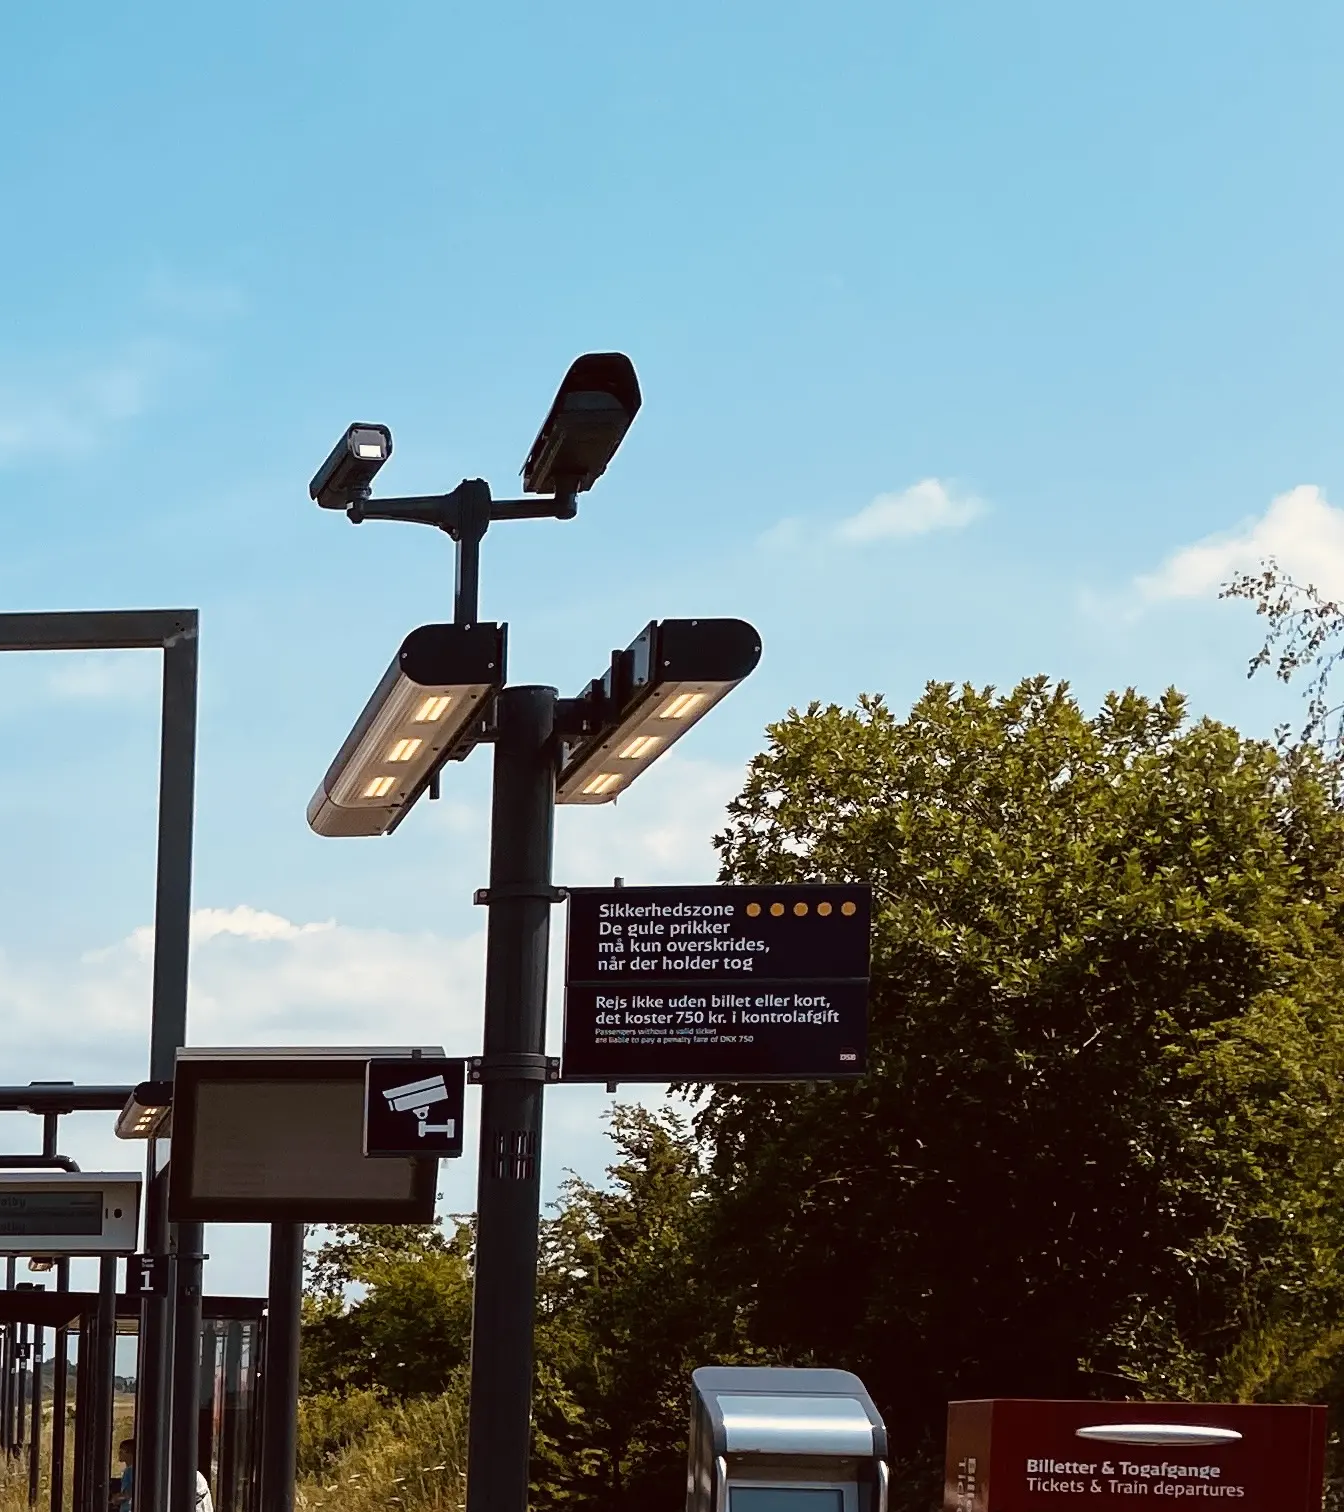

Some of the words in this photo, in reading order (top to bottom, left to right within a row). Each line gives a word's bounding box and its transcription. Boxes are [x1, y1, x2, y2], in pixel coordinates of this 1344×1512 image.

[599, 902, 735, 918] Sikkerhedszone
[599, 921, 623, 936] De
[627, 920, 665, 938] gule
[670, 919, 731, 938] prikker
[598, 938, 624, 953] må
[630, 938, 662, 953] kun
[666, 936, 770, 954] overskrides,
[597, 955, 627, 971] når
[630, 956, 659, 971] der
[662, 955, 720, 970] holder
[723, 956, 754, 972] tog
[595, 995, 628, 1011] Rejs
[632, 995, 664, 1008] ikke
[668, 994, 707, 1008] uden
[711, 994, 752, 1008] billet
[755, 993, 791, 1007] eller
[794, 993, 831, 1009] kort,
[595, 1011, 622, 1025] det
[625, 1011, 674, 1025] koster
[675, 1010, 705, 1024] 750
[708, 1010, 728, 1024] kr.
[732, 1010, 737, 1024] i
[741, 1009, 840, 1025] kontrolafgift
[140, 1270, 154, 1291] 1
[1026, 1458, 1098, 1475] Billetter
[1101, 1461, 1115, 1475] &
[1118, 1461, 1221, 1480] Togafgange
[1026, 1477, 1085, 1493] Tickets
[1090, 1479, 1102, 1493] &
[1108, 1479, 1148, 1495] Train
[1153, 1481, 1245, 1498] departures
